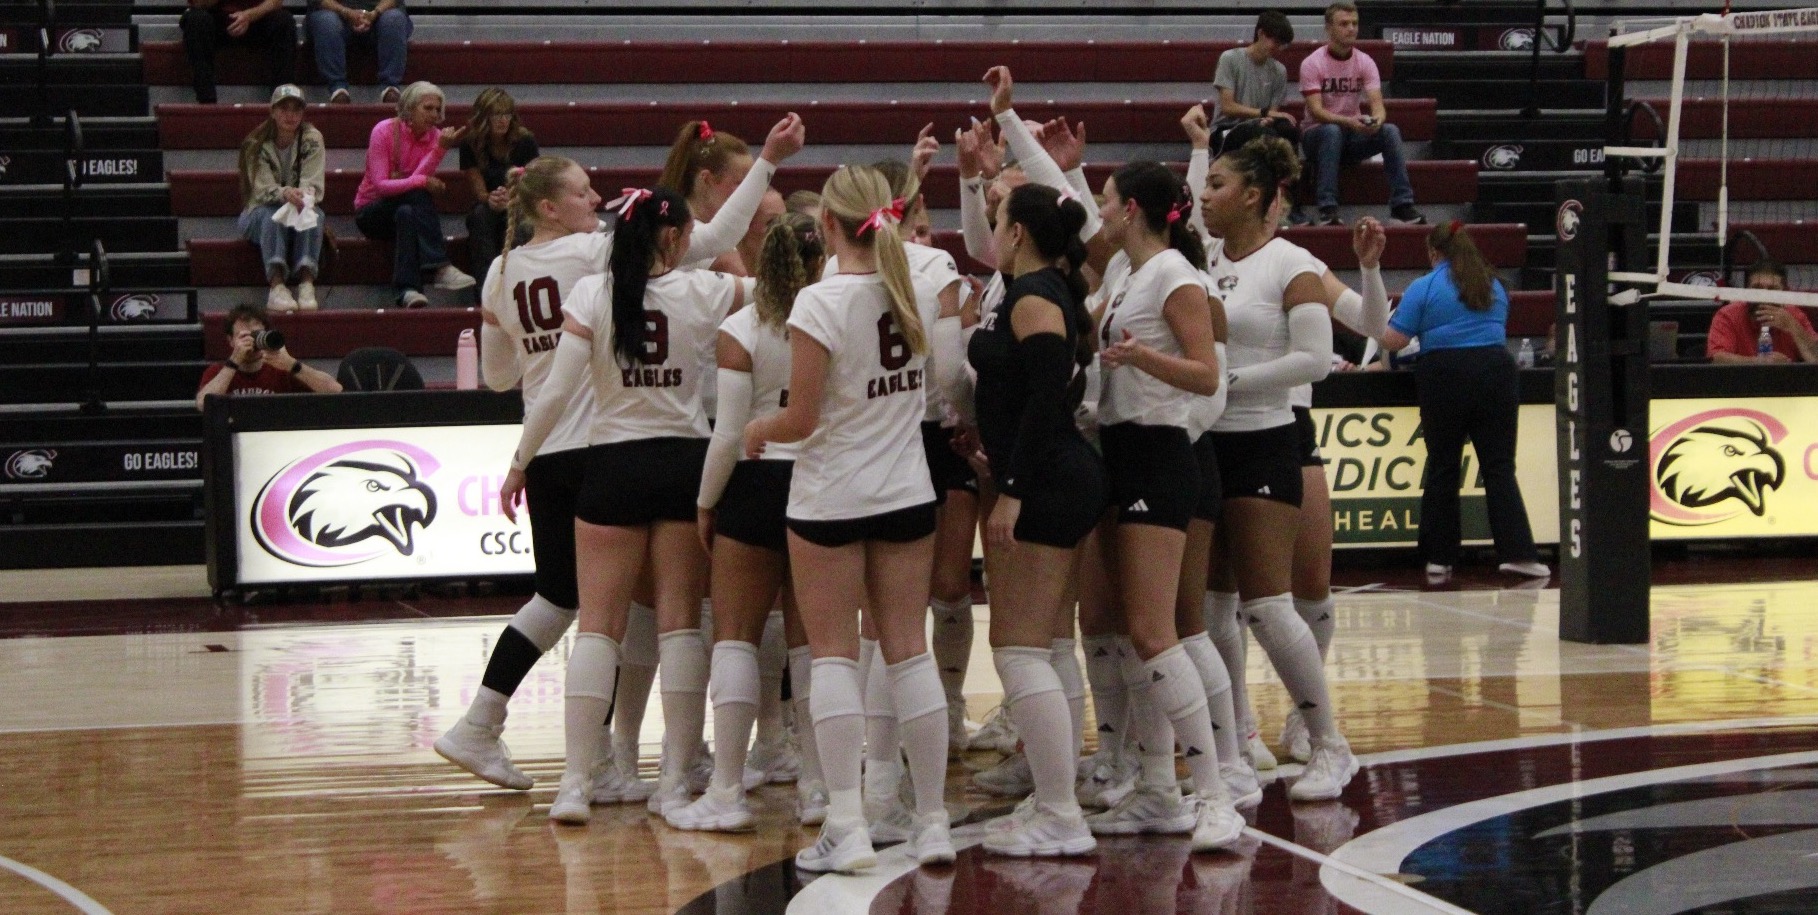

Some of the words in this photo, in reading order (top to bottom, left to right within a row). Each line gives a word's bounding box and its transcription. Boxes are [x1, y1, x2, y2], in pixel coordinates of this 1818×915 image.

[1392, 32, 1420, 45] EAGLE
[1422, 32, 1455, 45] NATION
[1574, 149, 1588, 163] GO
[89, 159, 138, 176] EAGLES!
[11, 301, 53, 317] NATION
[513, 275, 564, 334] 10
[877, 311, 912, 370] 6
[622, 368, 682, 387] EAGLES
[1565, 274, 1581, 559] EAGLES
[124, 453, 142, 470] GO
[145, 451, 198, 469] EAGLES!
